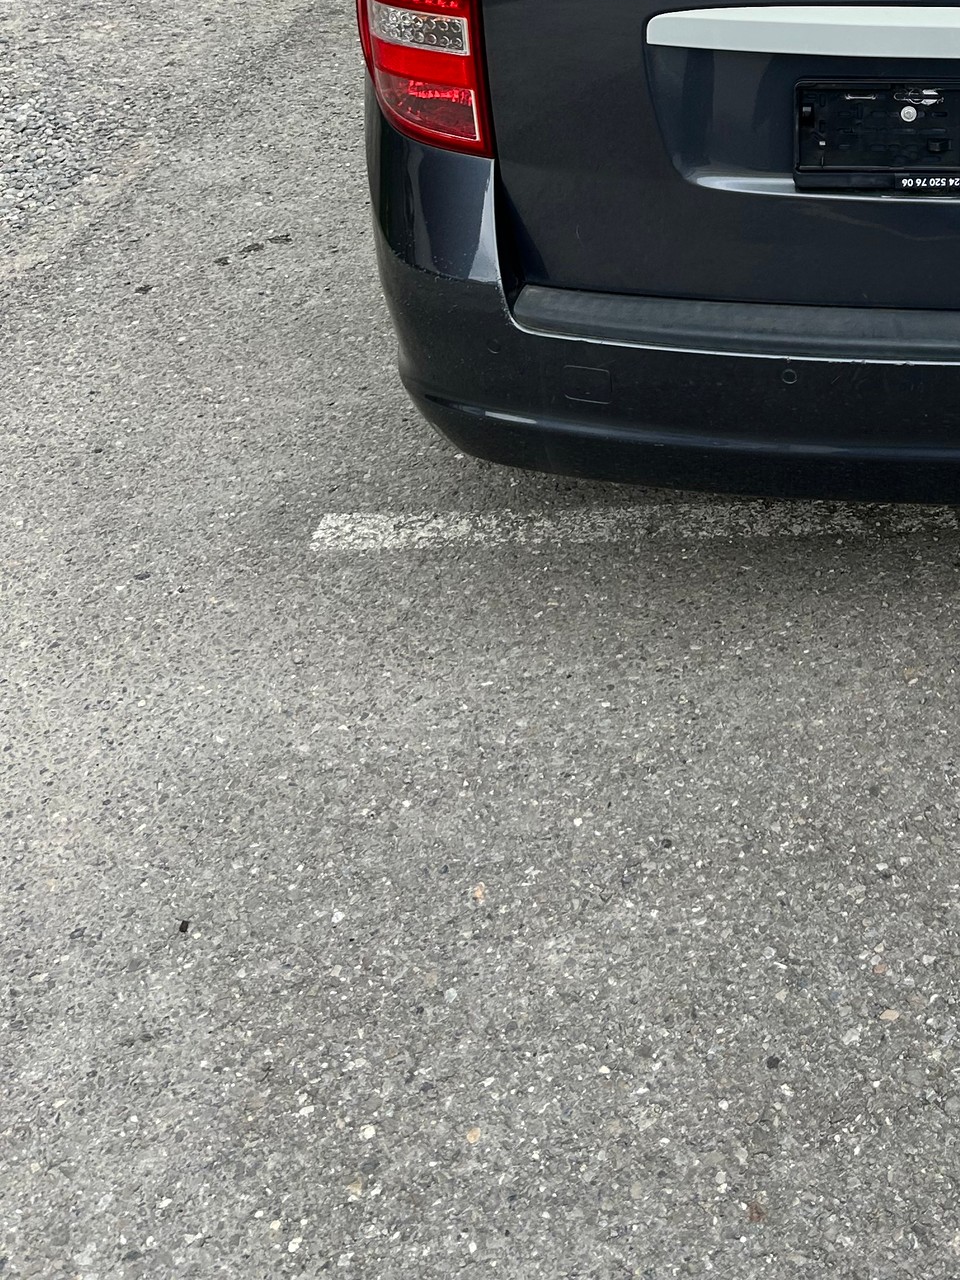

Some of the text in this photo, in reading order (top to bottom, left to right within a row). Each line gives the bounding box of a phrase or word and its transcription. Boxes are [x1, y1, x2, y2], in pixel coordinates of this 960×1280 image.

[901, 178, 914, 188] 06
[915, 178, 928, 187] 76
[929, 177, 947, 187] 520
